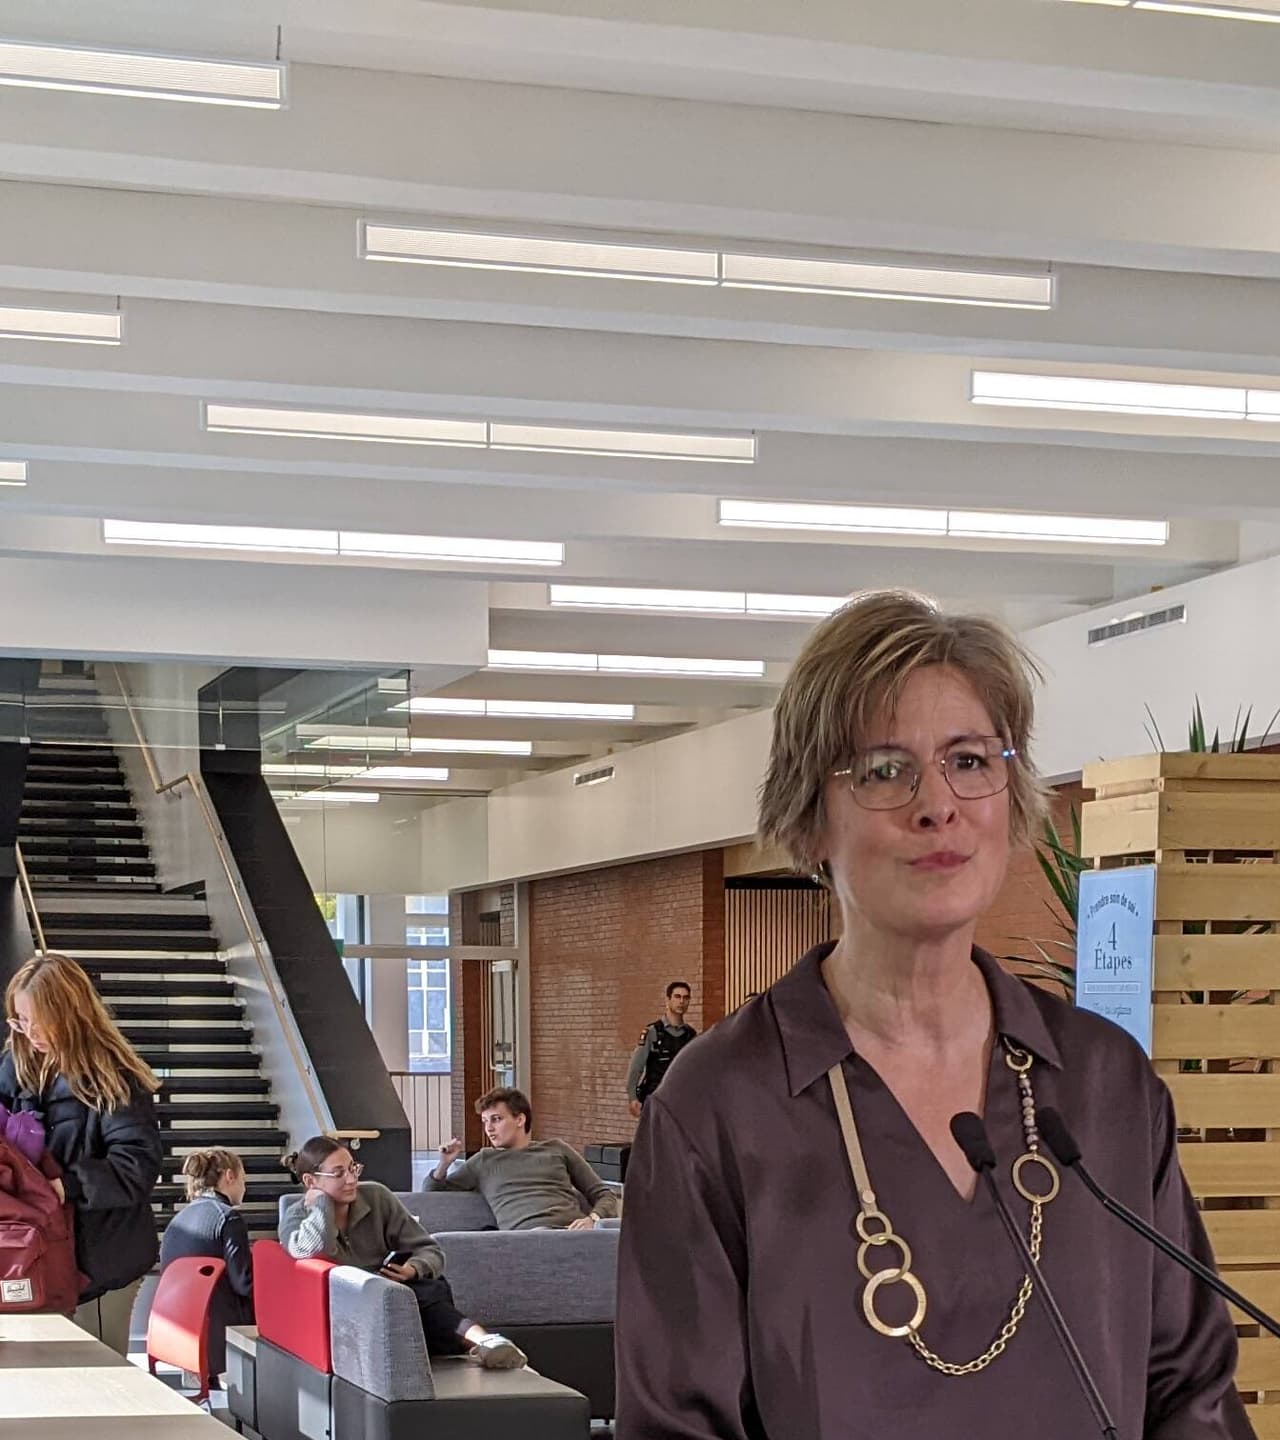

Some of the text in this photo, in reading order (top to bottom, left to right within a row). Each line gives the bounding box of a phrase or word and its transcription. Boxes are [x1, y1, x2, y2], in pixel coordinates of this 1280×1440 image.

[1121, 892, 1128, 907] de
[1107, 921, 1117, 951] 4
[1094, 941, 1132, 976] Étapes
